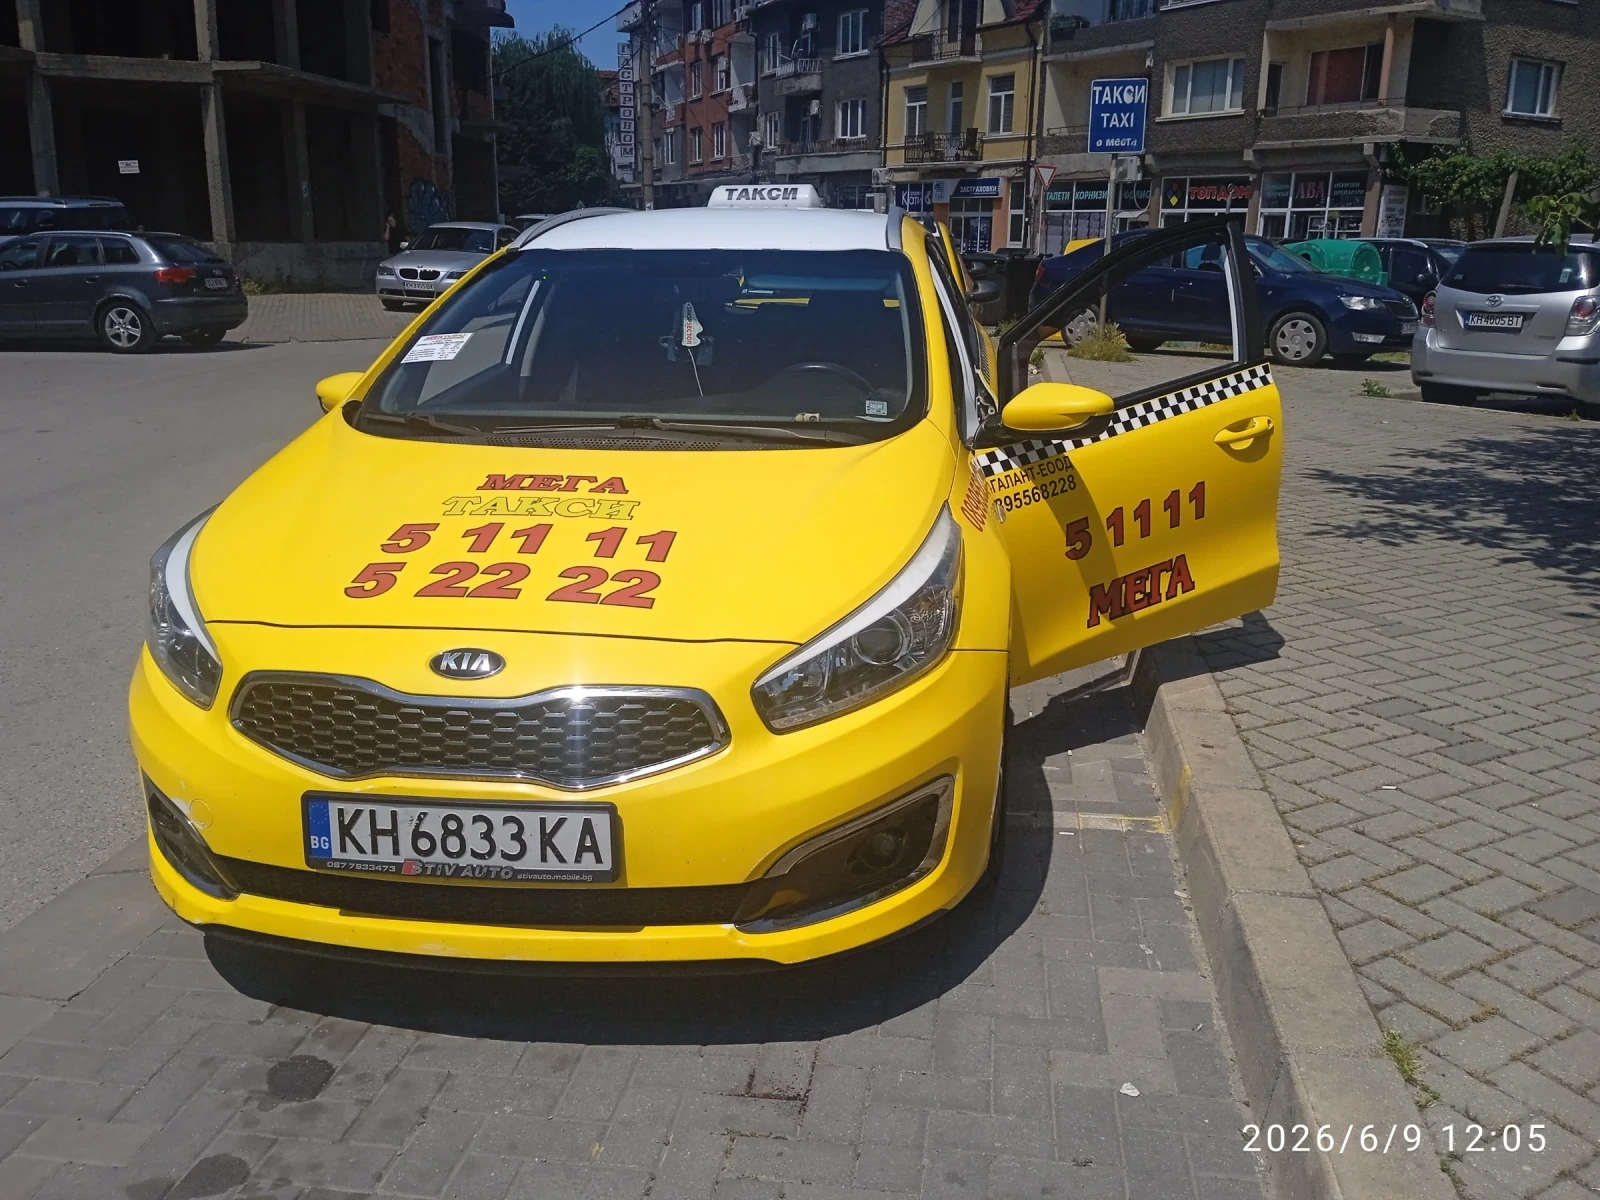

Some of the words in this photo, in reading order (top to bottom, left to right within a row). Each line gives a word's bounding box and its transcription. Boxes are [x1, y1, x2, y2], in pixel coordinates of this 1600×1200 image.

[620, 44, 635, 156] ГАСТРОНОМ
[1093, 85, 1145, 104] ТАКСИ
[1101, 113, 1134, 128] TAXI
[725, 187, 798, 201] ТАКСИ
[960, 185, 997, 193] ЗАСТРАХОВКИ
[1046, 191, 1070, 200] ТАПЕТИ
[476, 474, 629, 494] МЕГА
[442, 496, 640, 520] ТАКСИ
[381, 523, 440, 553] 5
[462, 522, 553, 554] 11
[586, 527, 677, 562] 11
[1065, 516, 1093, 560] 5
[344, 562, 407, 598] 5
[414, 561, 531, 599] 22
[545, 566, 661, 609] 22
[1086, 554, 1195, 629] МЕГА
[440, 652, 491, 671] KIA
[310, 836, 329, 849] BG
[460, 865, 515, 879] AUTO
[517, 872, 593, 881] stivauto.mobile.bg
